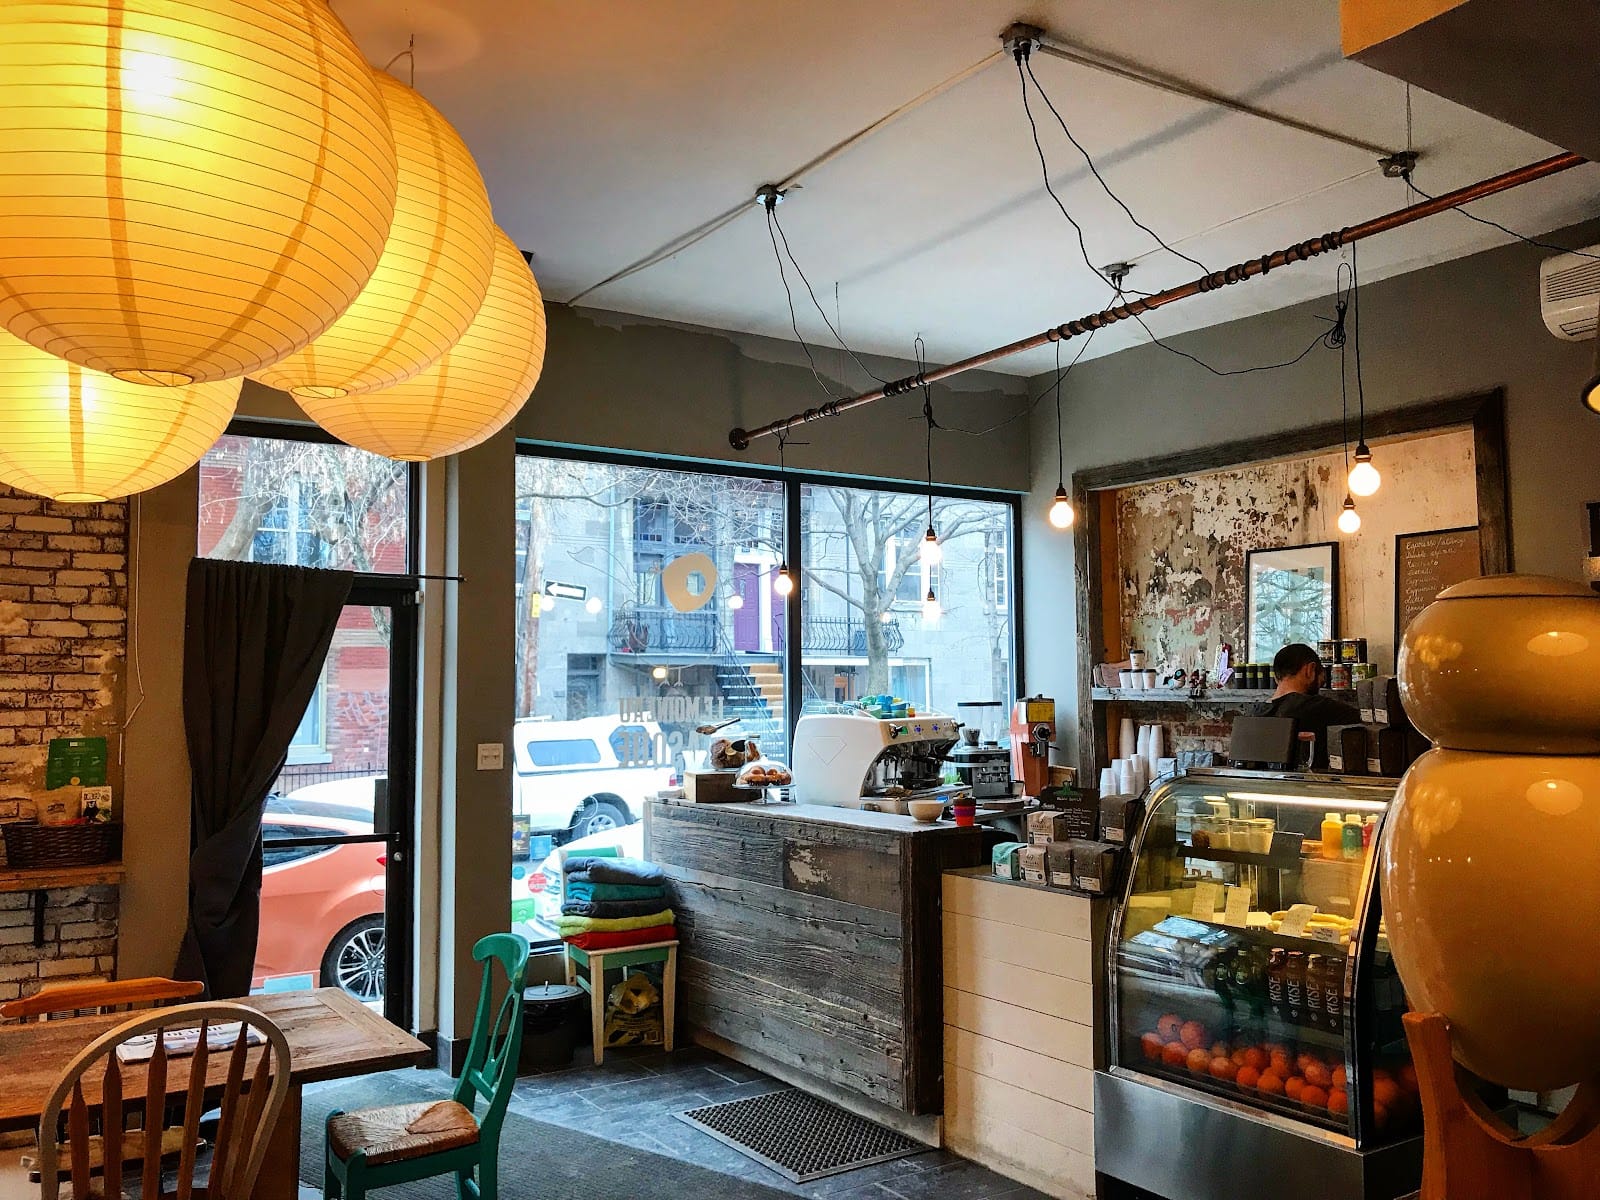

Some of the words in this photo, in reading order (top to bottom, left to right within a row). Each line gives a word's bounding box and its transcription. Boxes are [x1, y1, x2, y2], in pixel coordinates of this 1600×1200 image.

[1268, 976, 1282, 1001] RISE
[1287, 979, 1301, 1005] RISE
[1305, 980, 1321, 1008] RISE
[1325, 988, 1340, 1014] RISE
